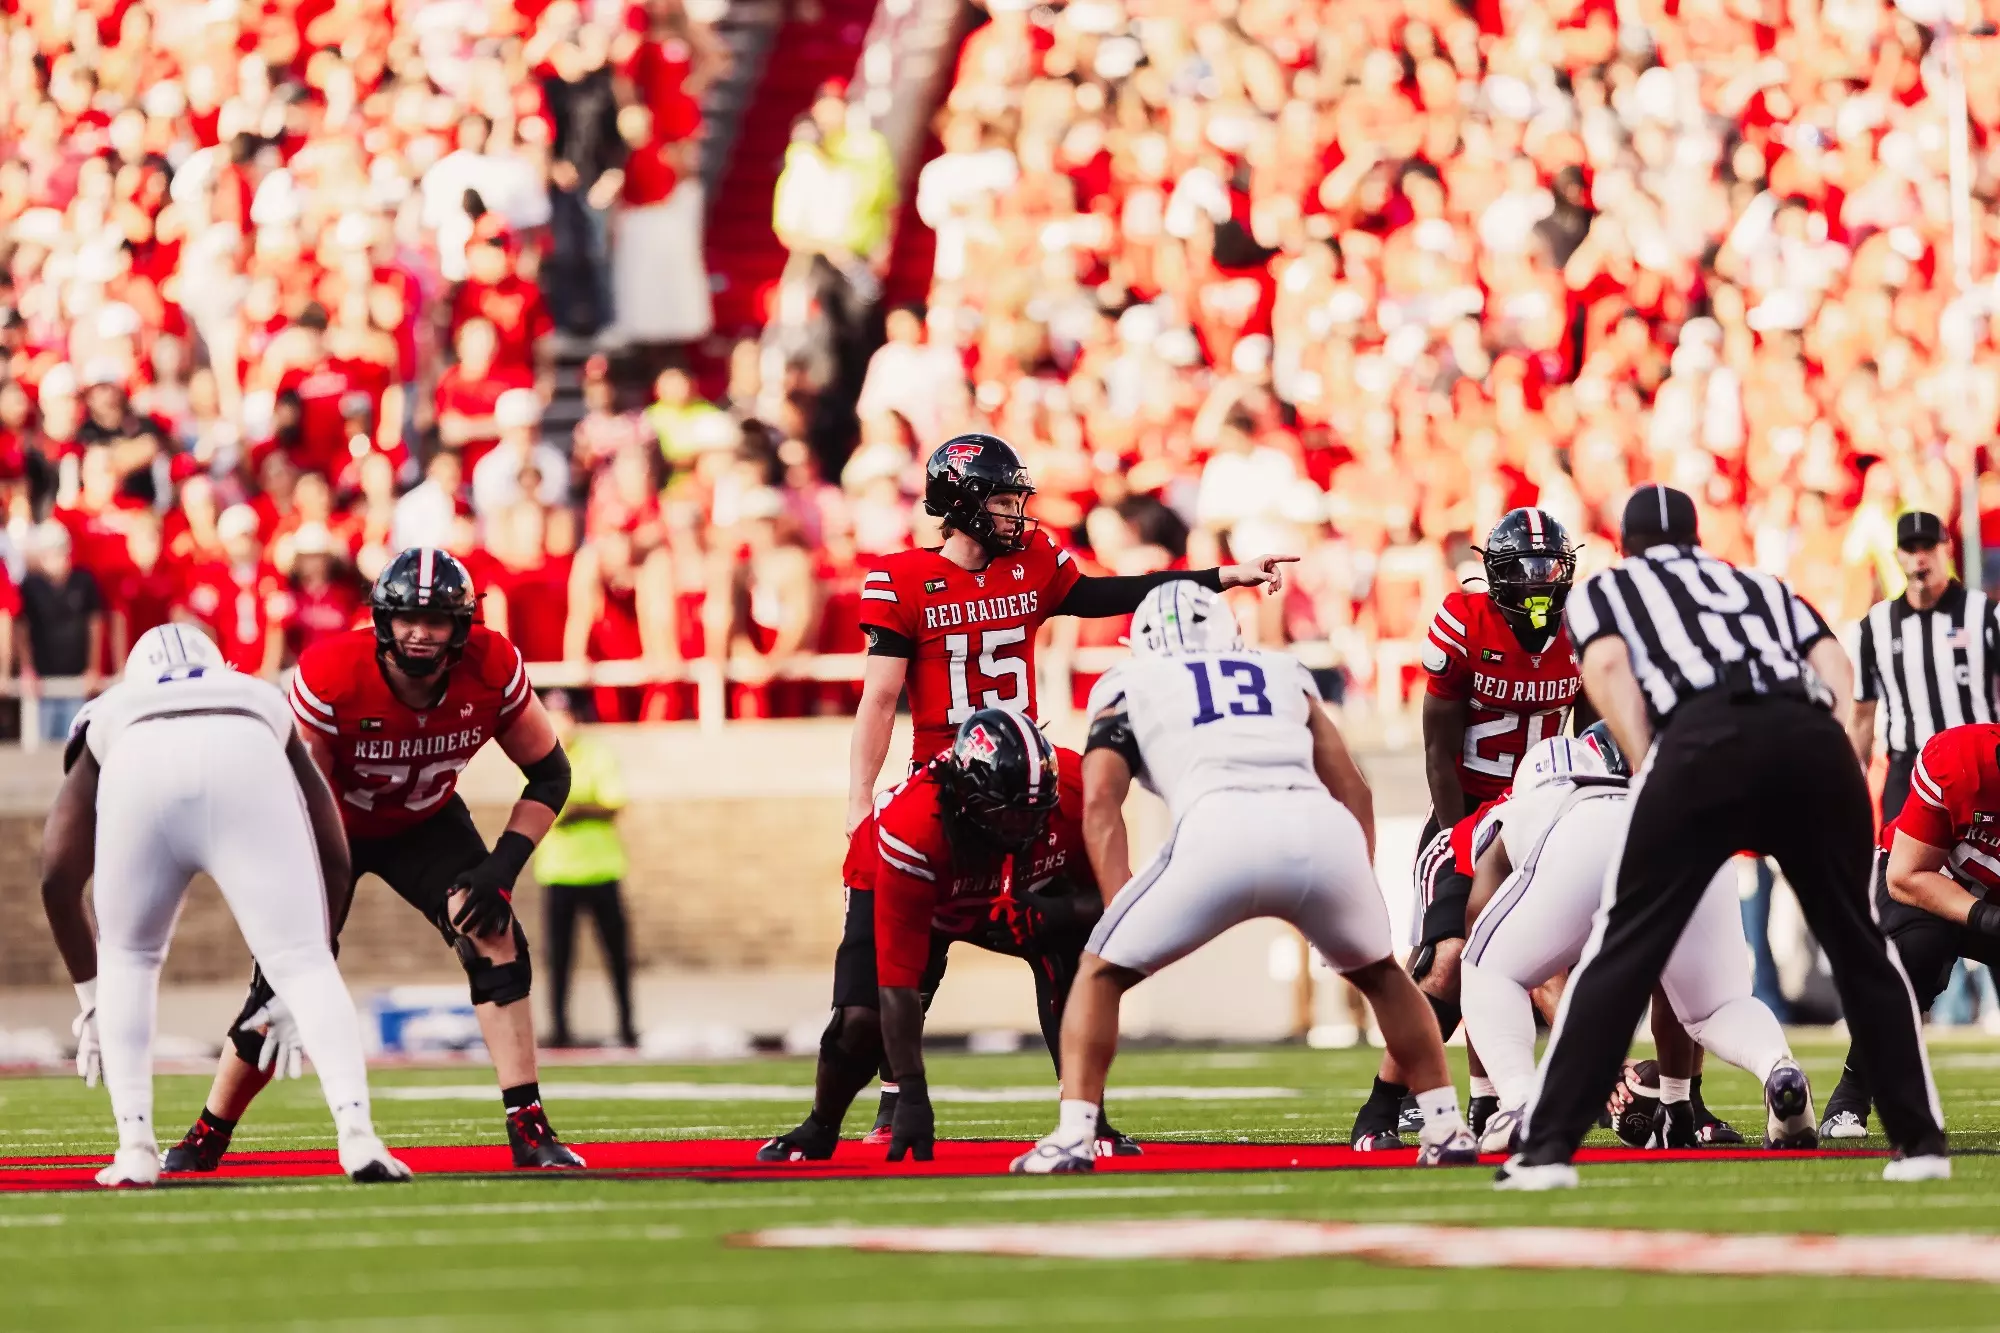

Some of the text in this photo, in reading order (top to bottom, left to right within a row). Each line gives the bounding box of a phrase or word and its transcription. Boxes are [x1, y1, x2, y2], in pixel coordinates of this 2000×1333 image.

[925, 590, 1038, 629] RED RAIDERS
[946, 625, 1027, 724] 15
[1184, 659, 1273, 727] 13
[1473, 671, 1583, 702] RED RAIDERS
[354, 725, 482, 759] RED RAIDERS
[1462, 698, 1569, 778] 20
[343, 758, 469, 812] 70
